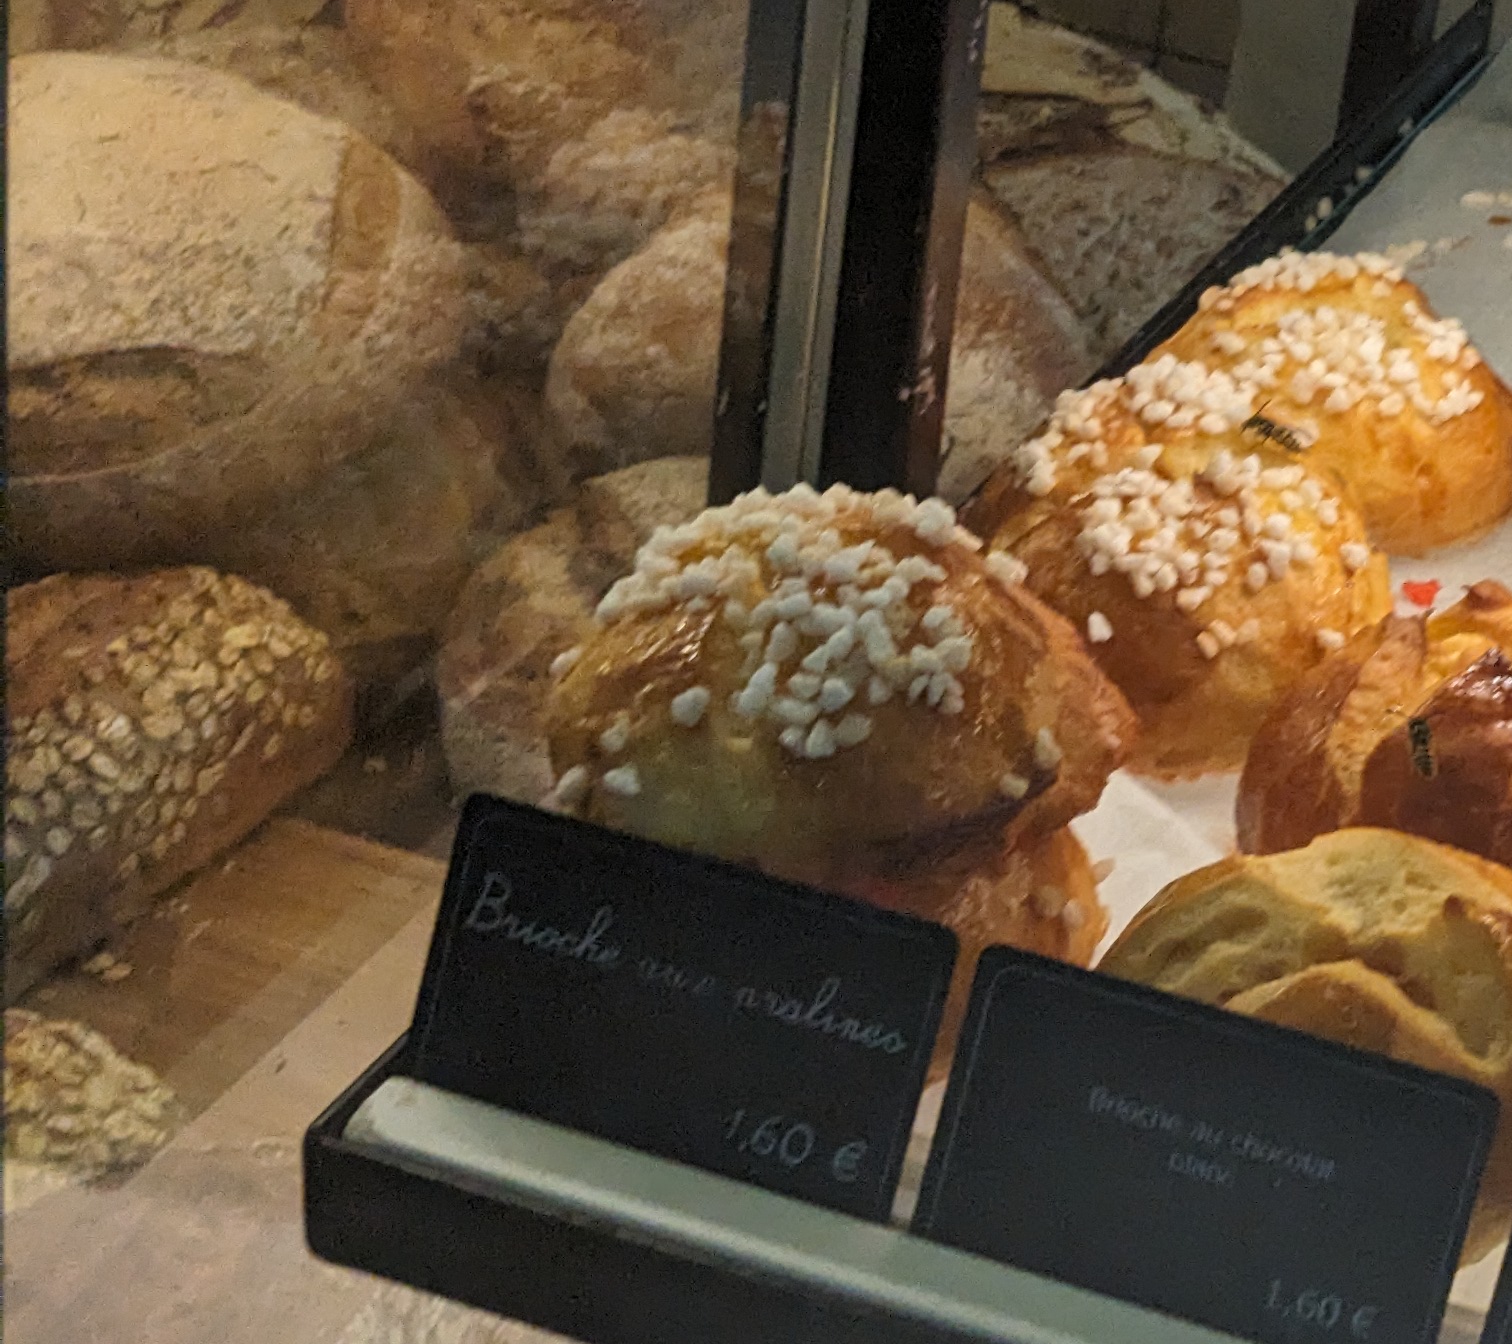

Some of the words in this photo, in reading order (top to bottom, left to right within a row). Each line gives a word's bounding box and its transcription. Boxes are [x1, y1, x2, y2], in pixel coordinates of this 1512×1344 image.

[463, 870, 621, 968] Brioche
[733, 975, 907, 1056] pralines
[725, 1108, 815, 1167] 1,60
[831, 1139, 869, 1184] €
[1265, 1277, 1343, 1331] 1,60
[1350, 1304, 1380, 1341] €
